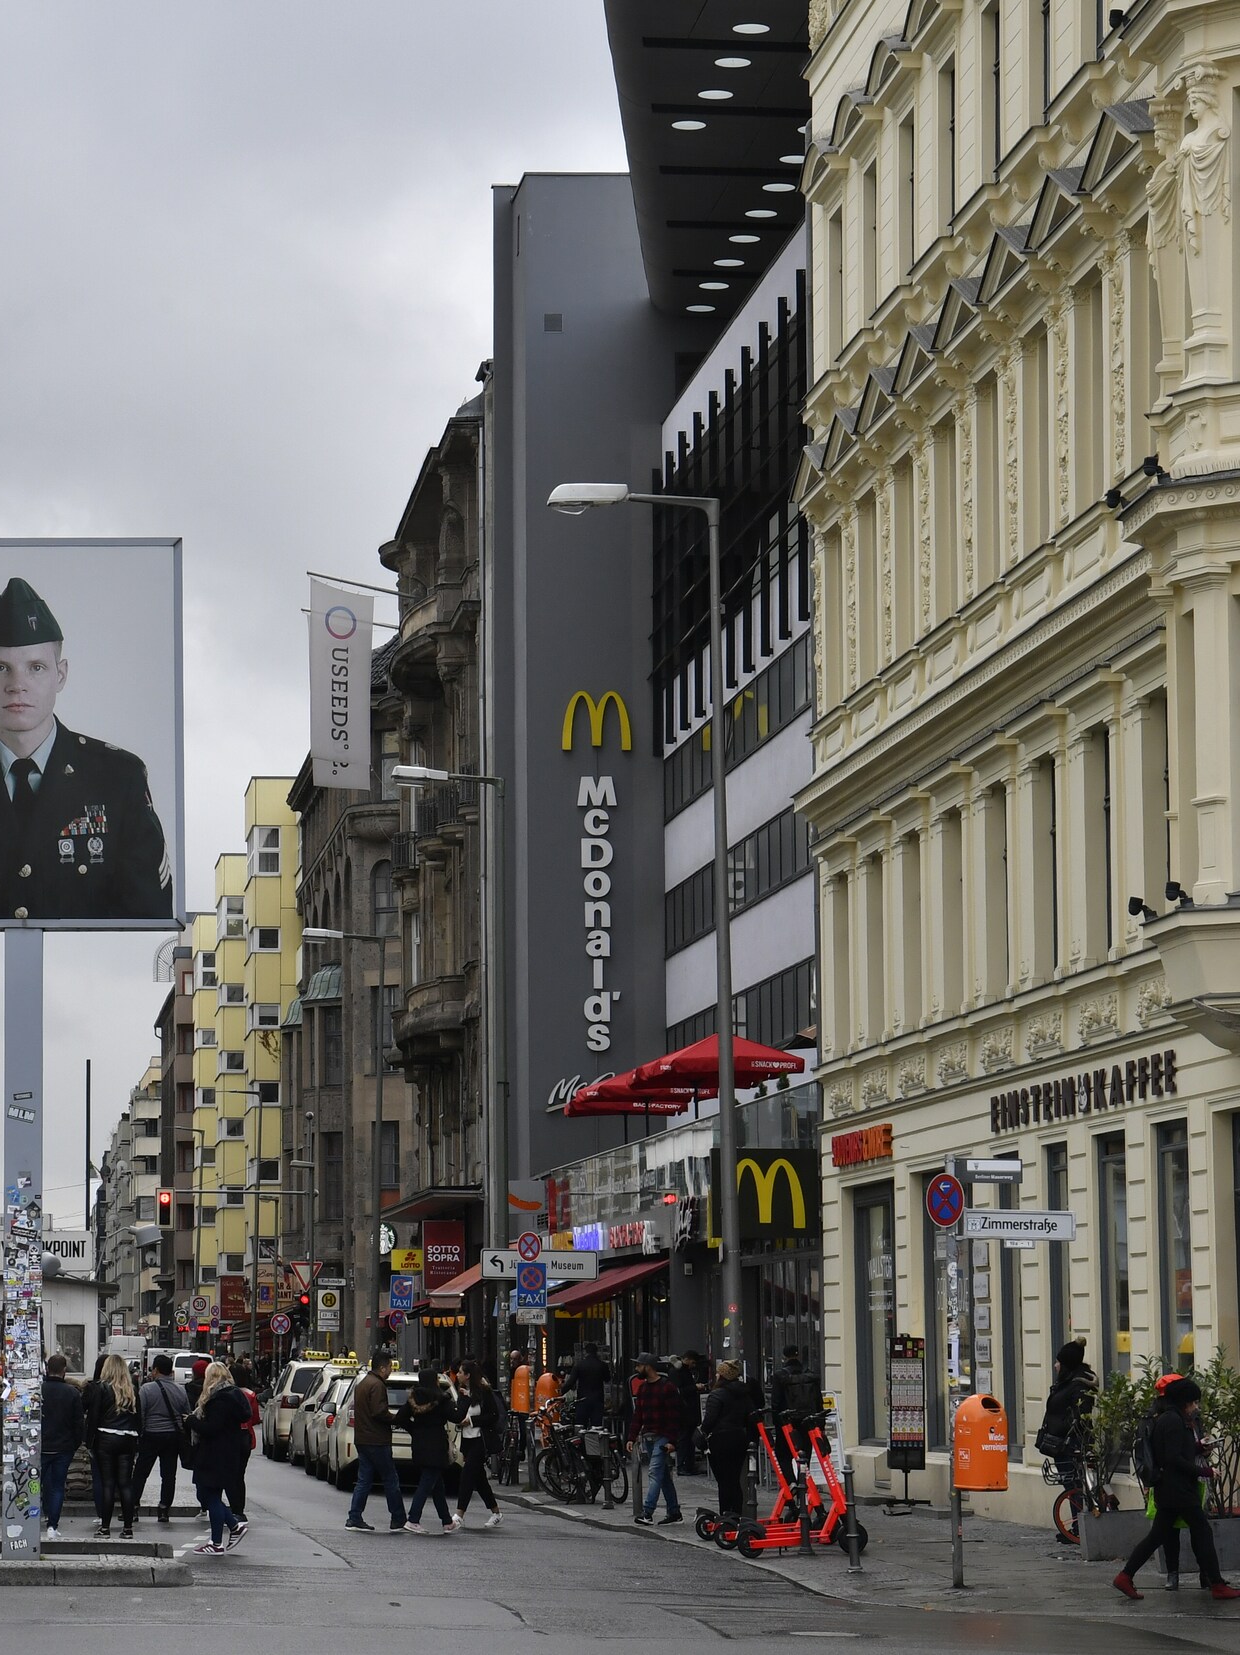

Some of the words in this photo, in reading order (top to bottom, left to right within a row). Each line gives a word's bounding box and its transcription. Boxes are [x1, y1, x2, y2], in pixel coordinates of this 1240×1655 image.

[577, 776, 621, 1051] McDonald's
[990, 1076, 1077, 1132] EINSTEIN
[1093, 1049, 1177, 1110] KAFFEE
[981, 1217, 1057, 1233] Zimmerstraße
[42, 1241, 87, 1258] KPOINT
[427, 1245, 460, 1253] SOTTO
[427, 1254, 460, 1262] SOPRA
[551, 1260, 584, 1270] Museum
[392, 1299, 410, 1307] TAXI
[520, 1293, 544, 1304] TAXI
